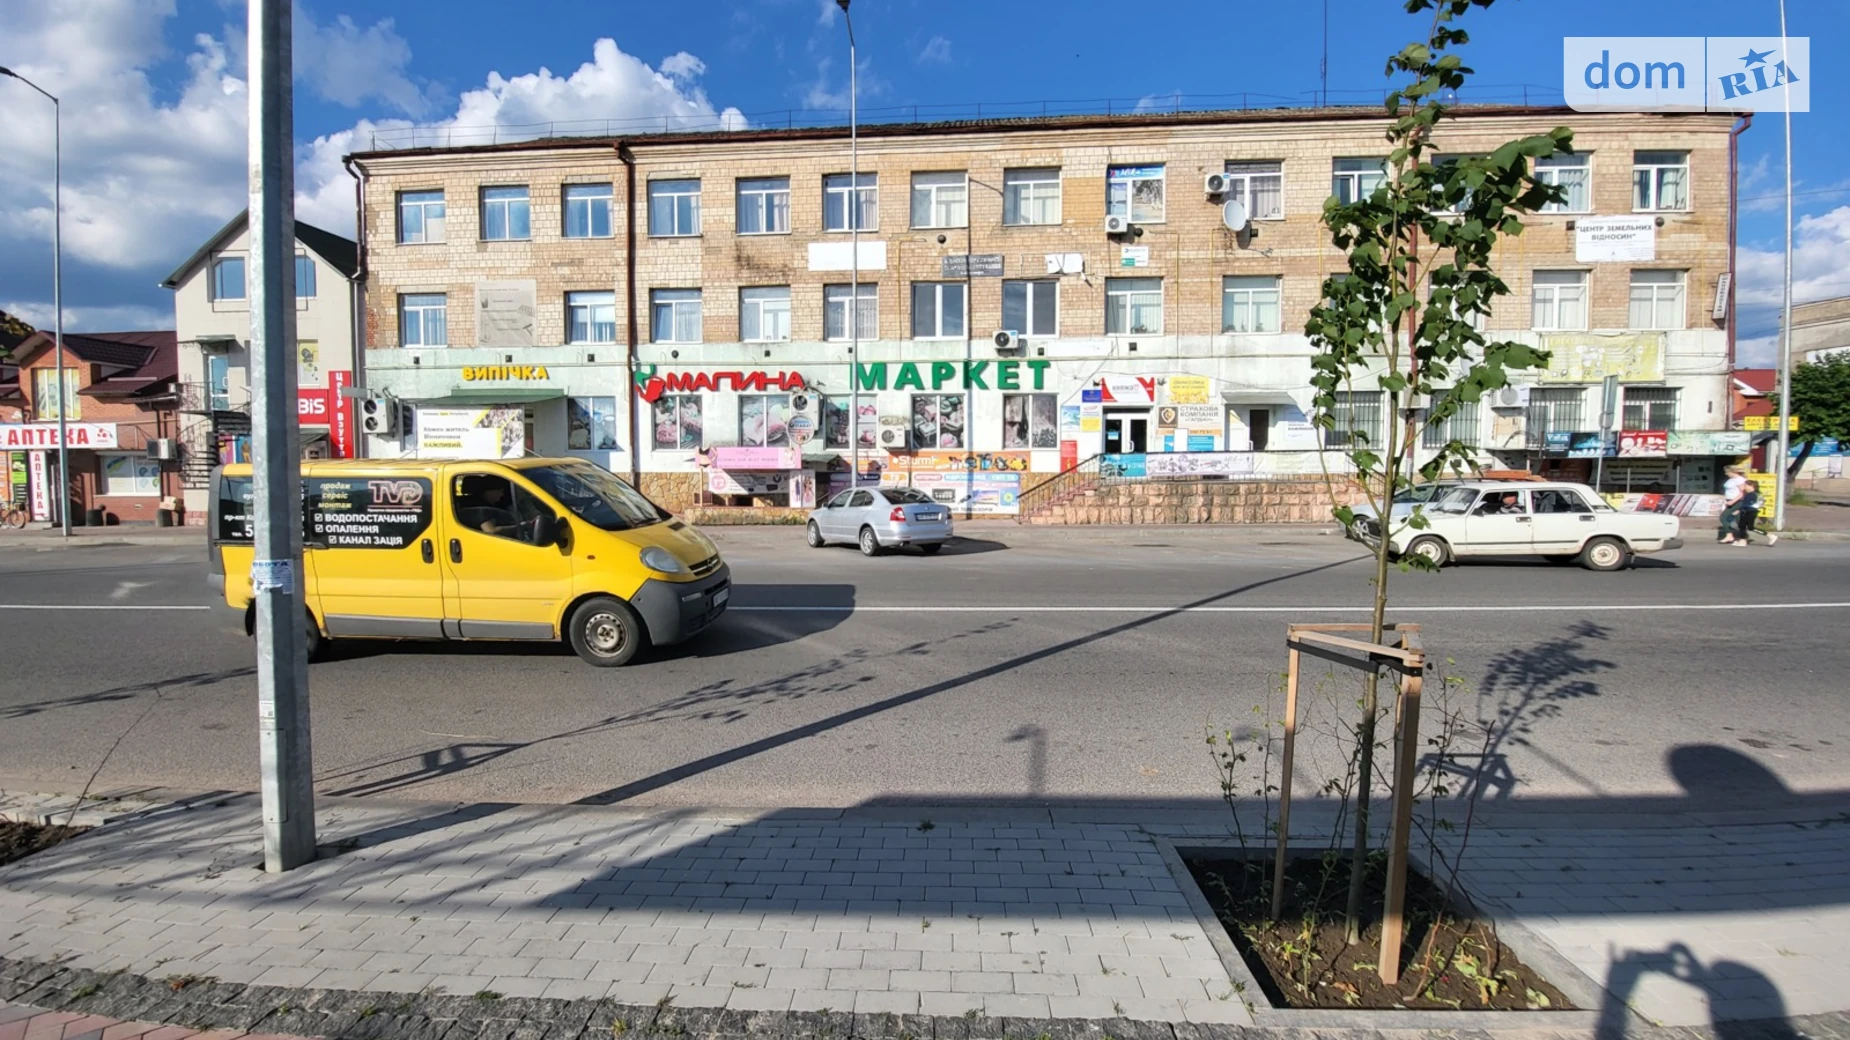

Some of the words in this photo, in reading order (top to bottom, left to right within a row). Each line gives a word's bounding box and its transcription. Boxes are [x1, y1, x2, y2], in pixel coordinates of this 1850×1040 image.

[1606, 224, 1652, 232] ЗЕМЕЛЬНИХ
[462, 365, 549, 381] ВИПІЧКА
[850, 360, 1050, 391] МАРКЕТ
[7, 428, 90, 446] АПТЕКА
[34, 453, 44, 509] АПТЕКА
[320, 482, 352, 492] продаж
[322, 491, 349, 500] сервіс
[325, 514, 418, 523] ВОДОПОСТАЧАННЯ
[325, 525, 379, 534] ОПАЛЕННЯ
